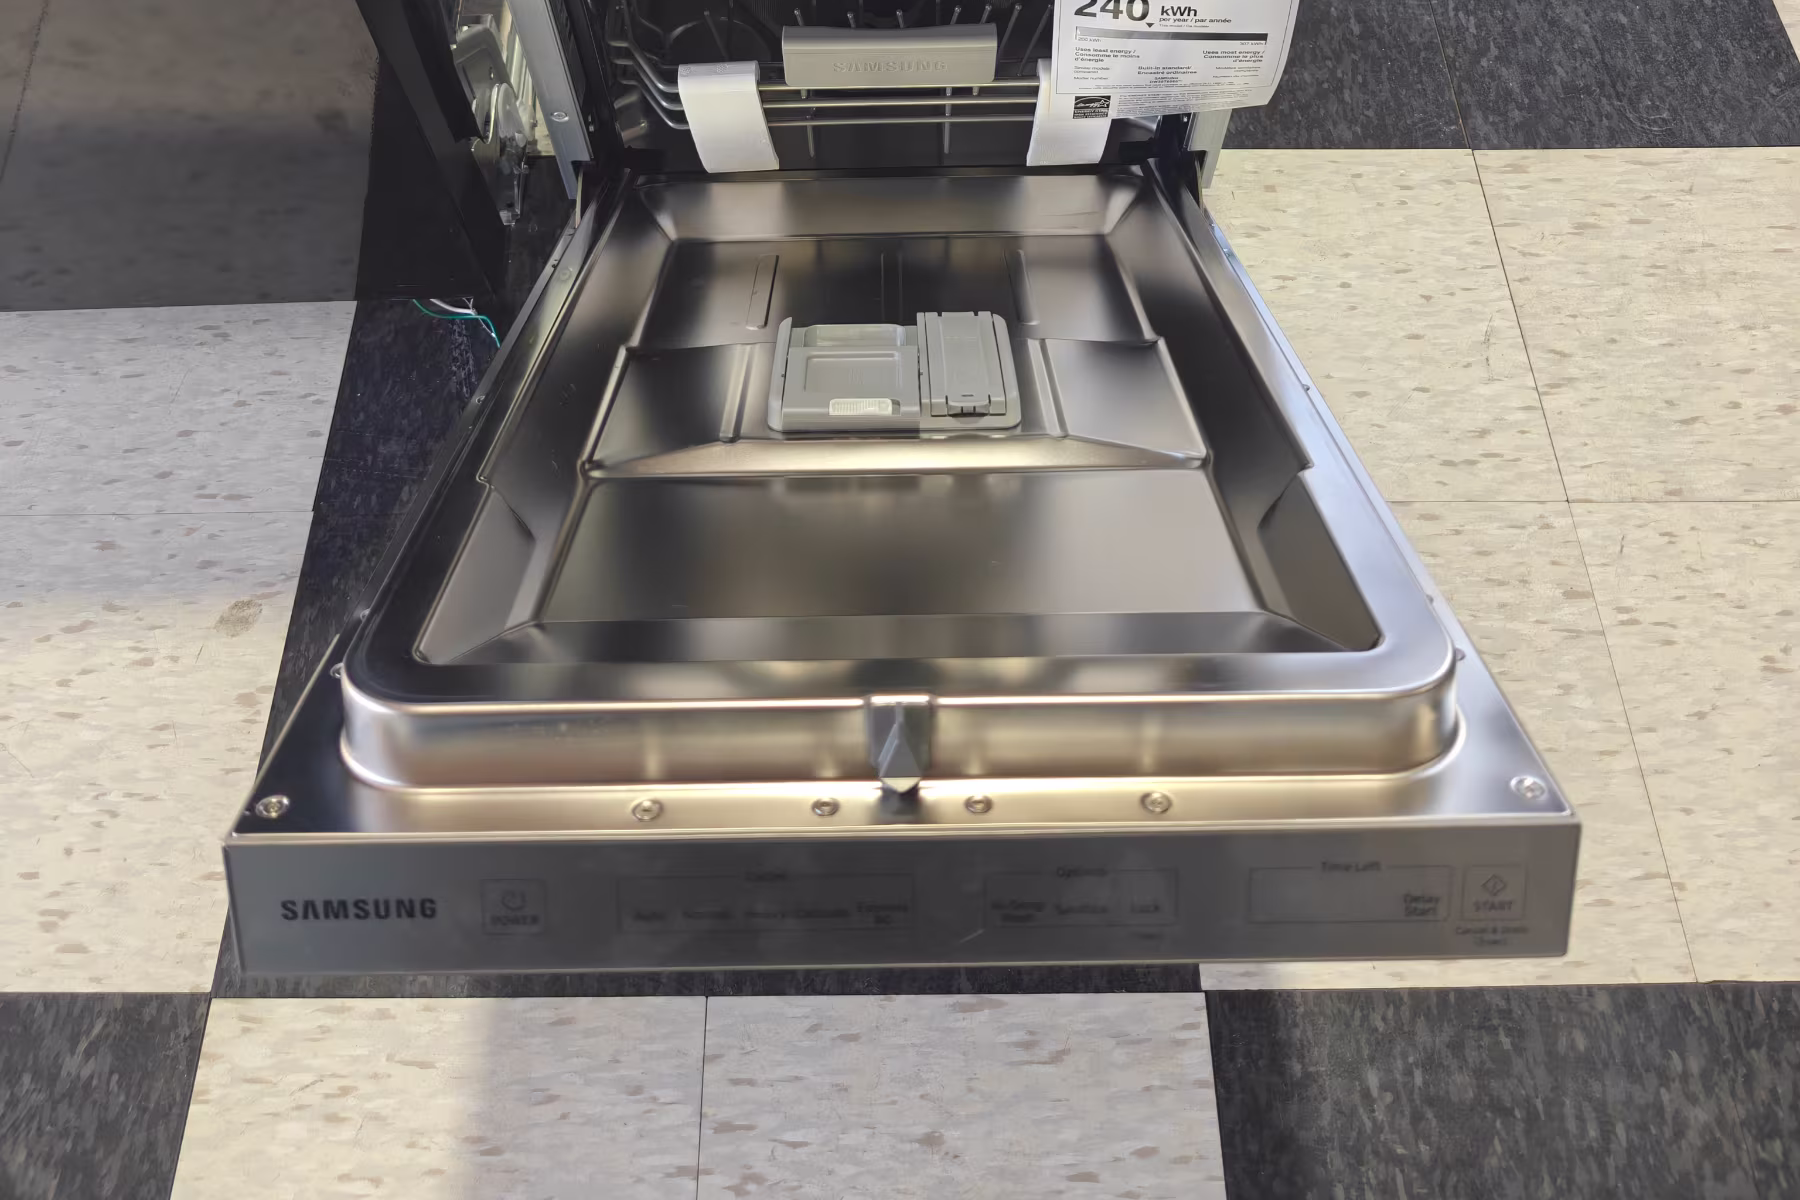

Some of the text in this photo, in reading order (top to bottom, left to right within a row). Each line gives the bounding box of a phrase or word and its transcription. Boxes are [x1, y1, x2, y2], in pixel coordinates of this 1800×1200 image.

[1160, 5, 1198, 17] kWh
[832, 59, 948, 74] SAMSUNG
[281, 897, 437, 922] SAMSUNG
